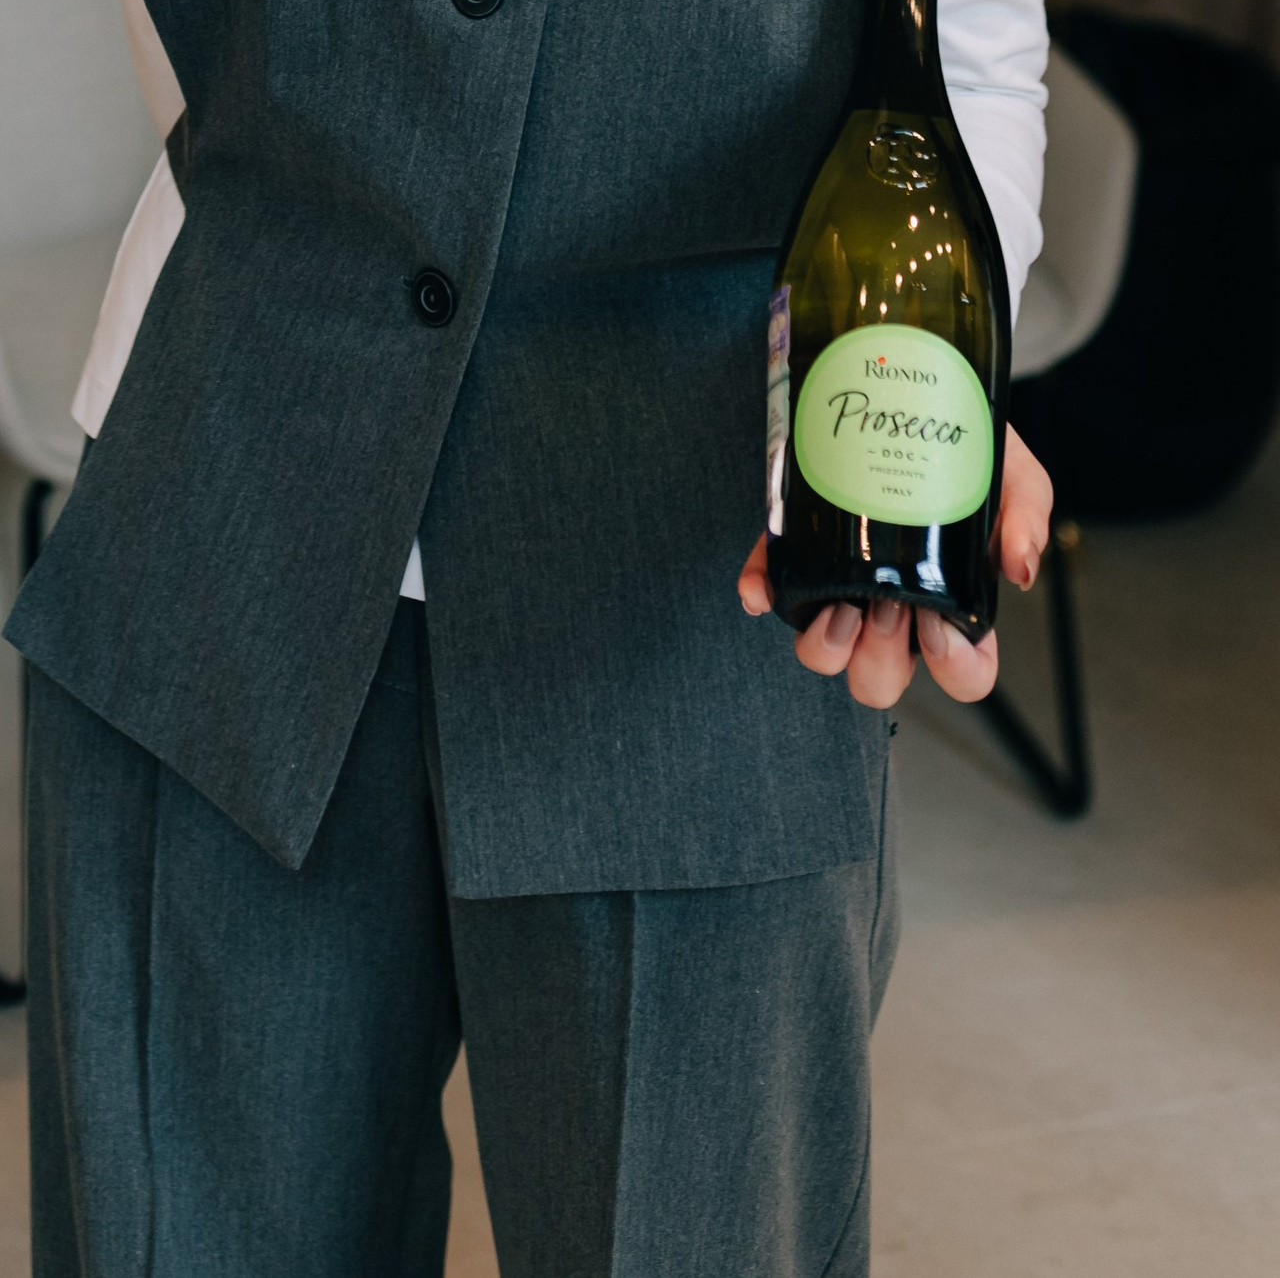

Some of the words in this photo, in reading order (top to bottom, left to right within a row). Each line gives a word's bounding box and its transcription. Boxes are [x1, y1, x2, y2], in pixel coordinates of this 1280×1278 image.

[827, 390, 969, 446] Prosecco
[869, 466, 926, 480] FRIZZANTE
[881, 486, 914, 497] ITALY
